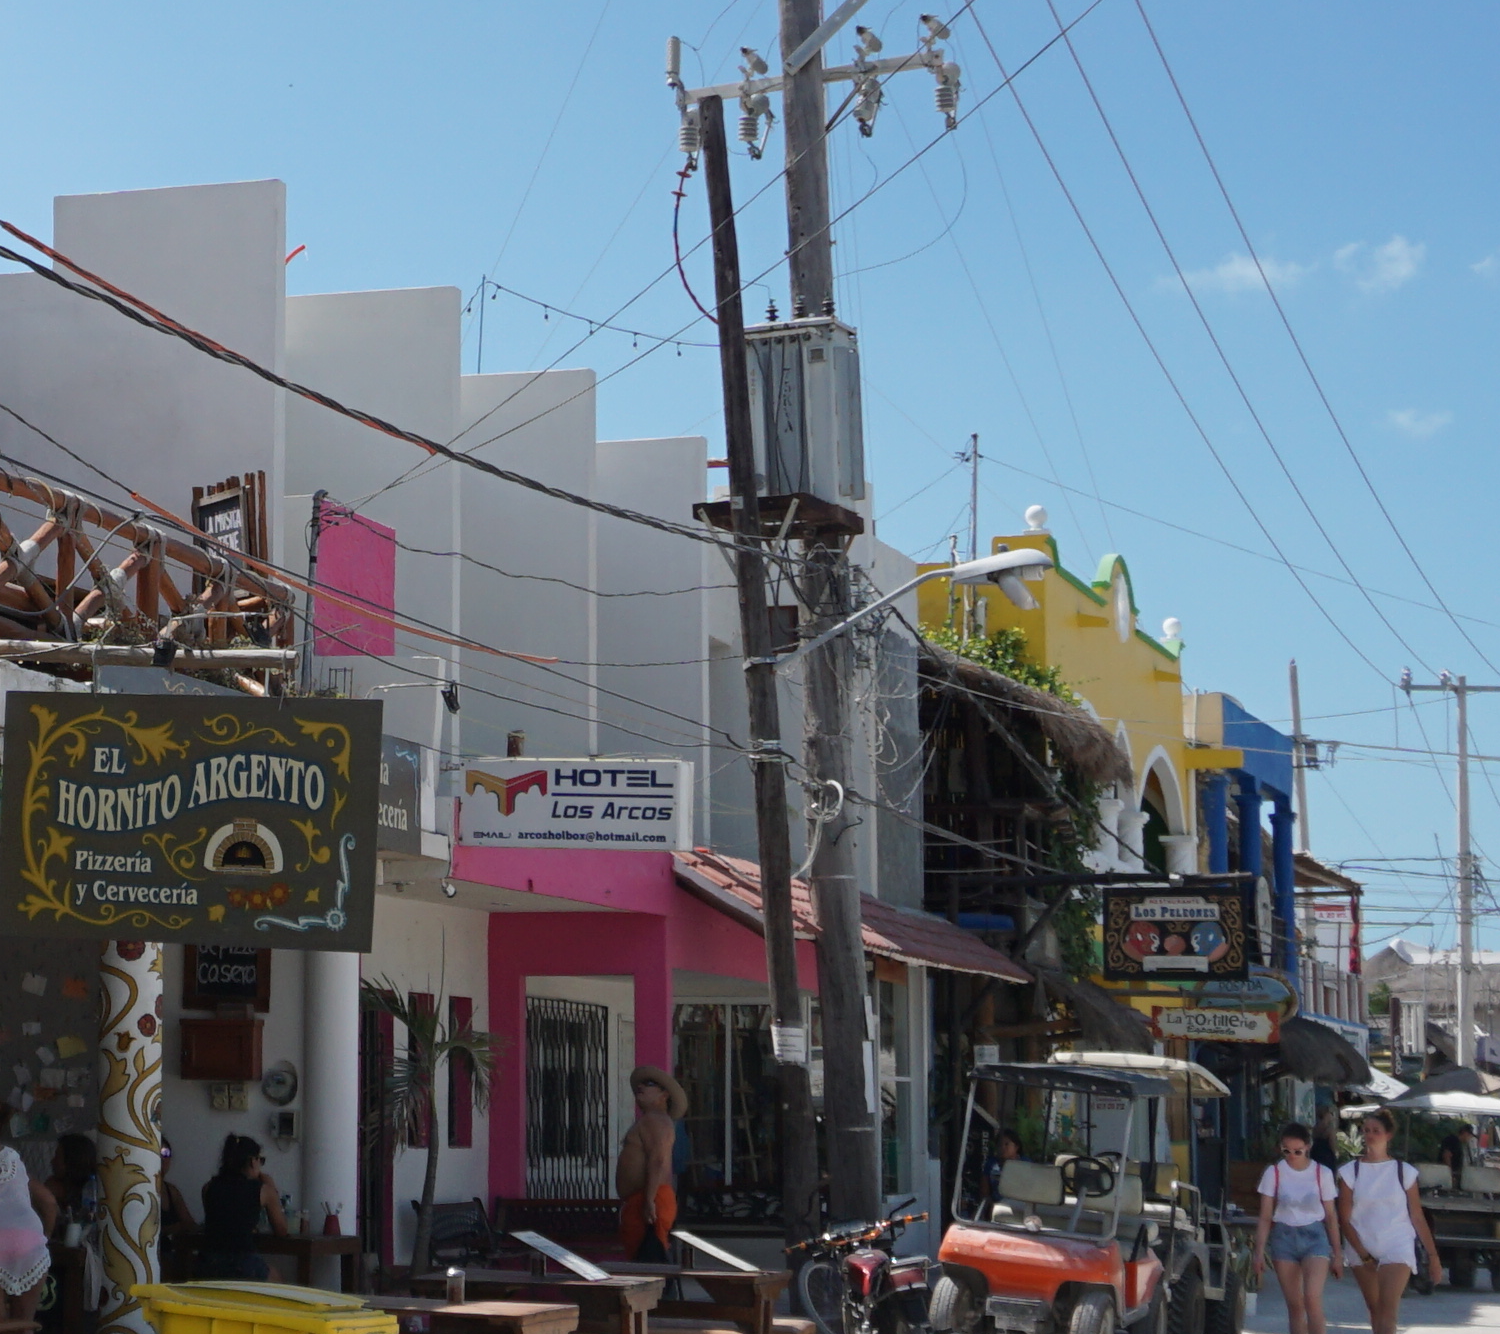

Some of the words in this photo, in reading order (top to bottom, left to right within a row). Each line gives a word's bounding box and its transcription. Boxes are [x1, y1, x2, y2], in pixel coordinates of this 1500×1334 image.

[93, 747, 126, 773] EL
[187, 753, 325, 811] ARGENTO
[554, 768, 674, 788] HOTEL
[551, 801, 595, 819] Los
[601, 802, 674, 820] Arcos
[74, 850, 152, 873] Pizzería
[75, 883, 86, 906] y
[93, 880, 199, 906] Cervecería
[1134, 906, 1156, 918] LOS
[1166, 1013, 1183, 1024] La
